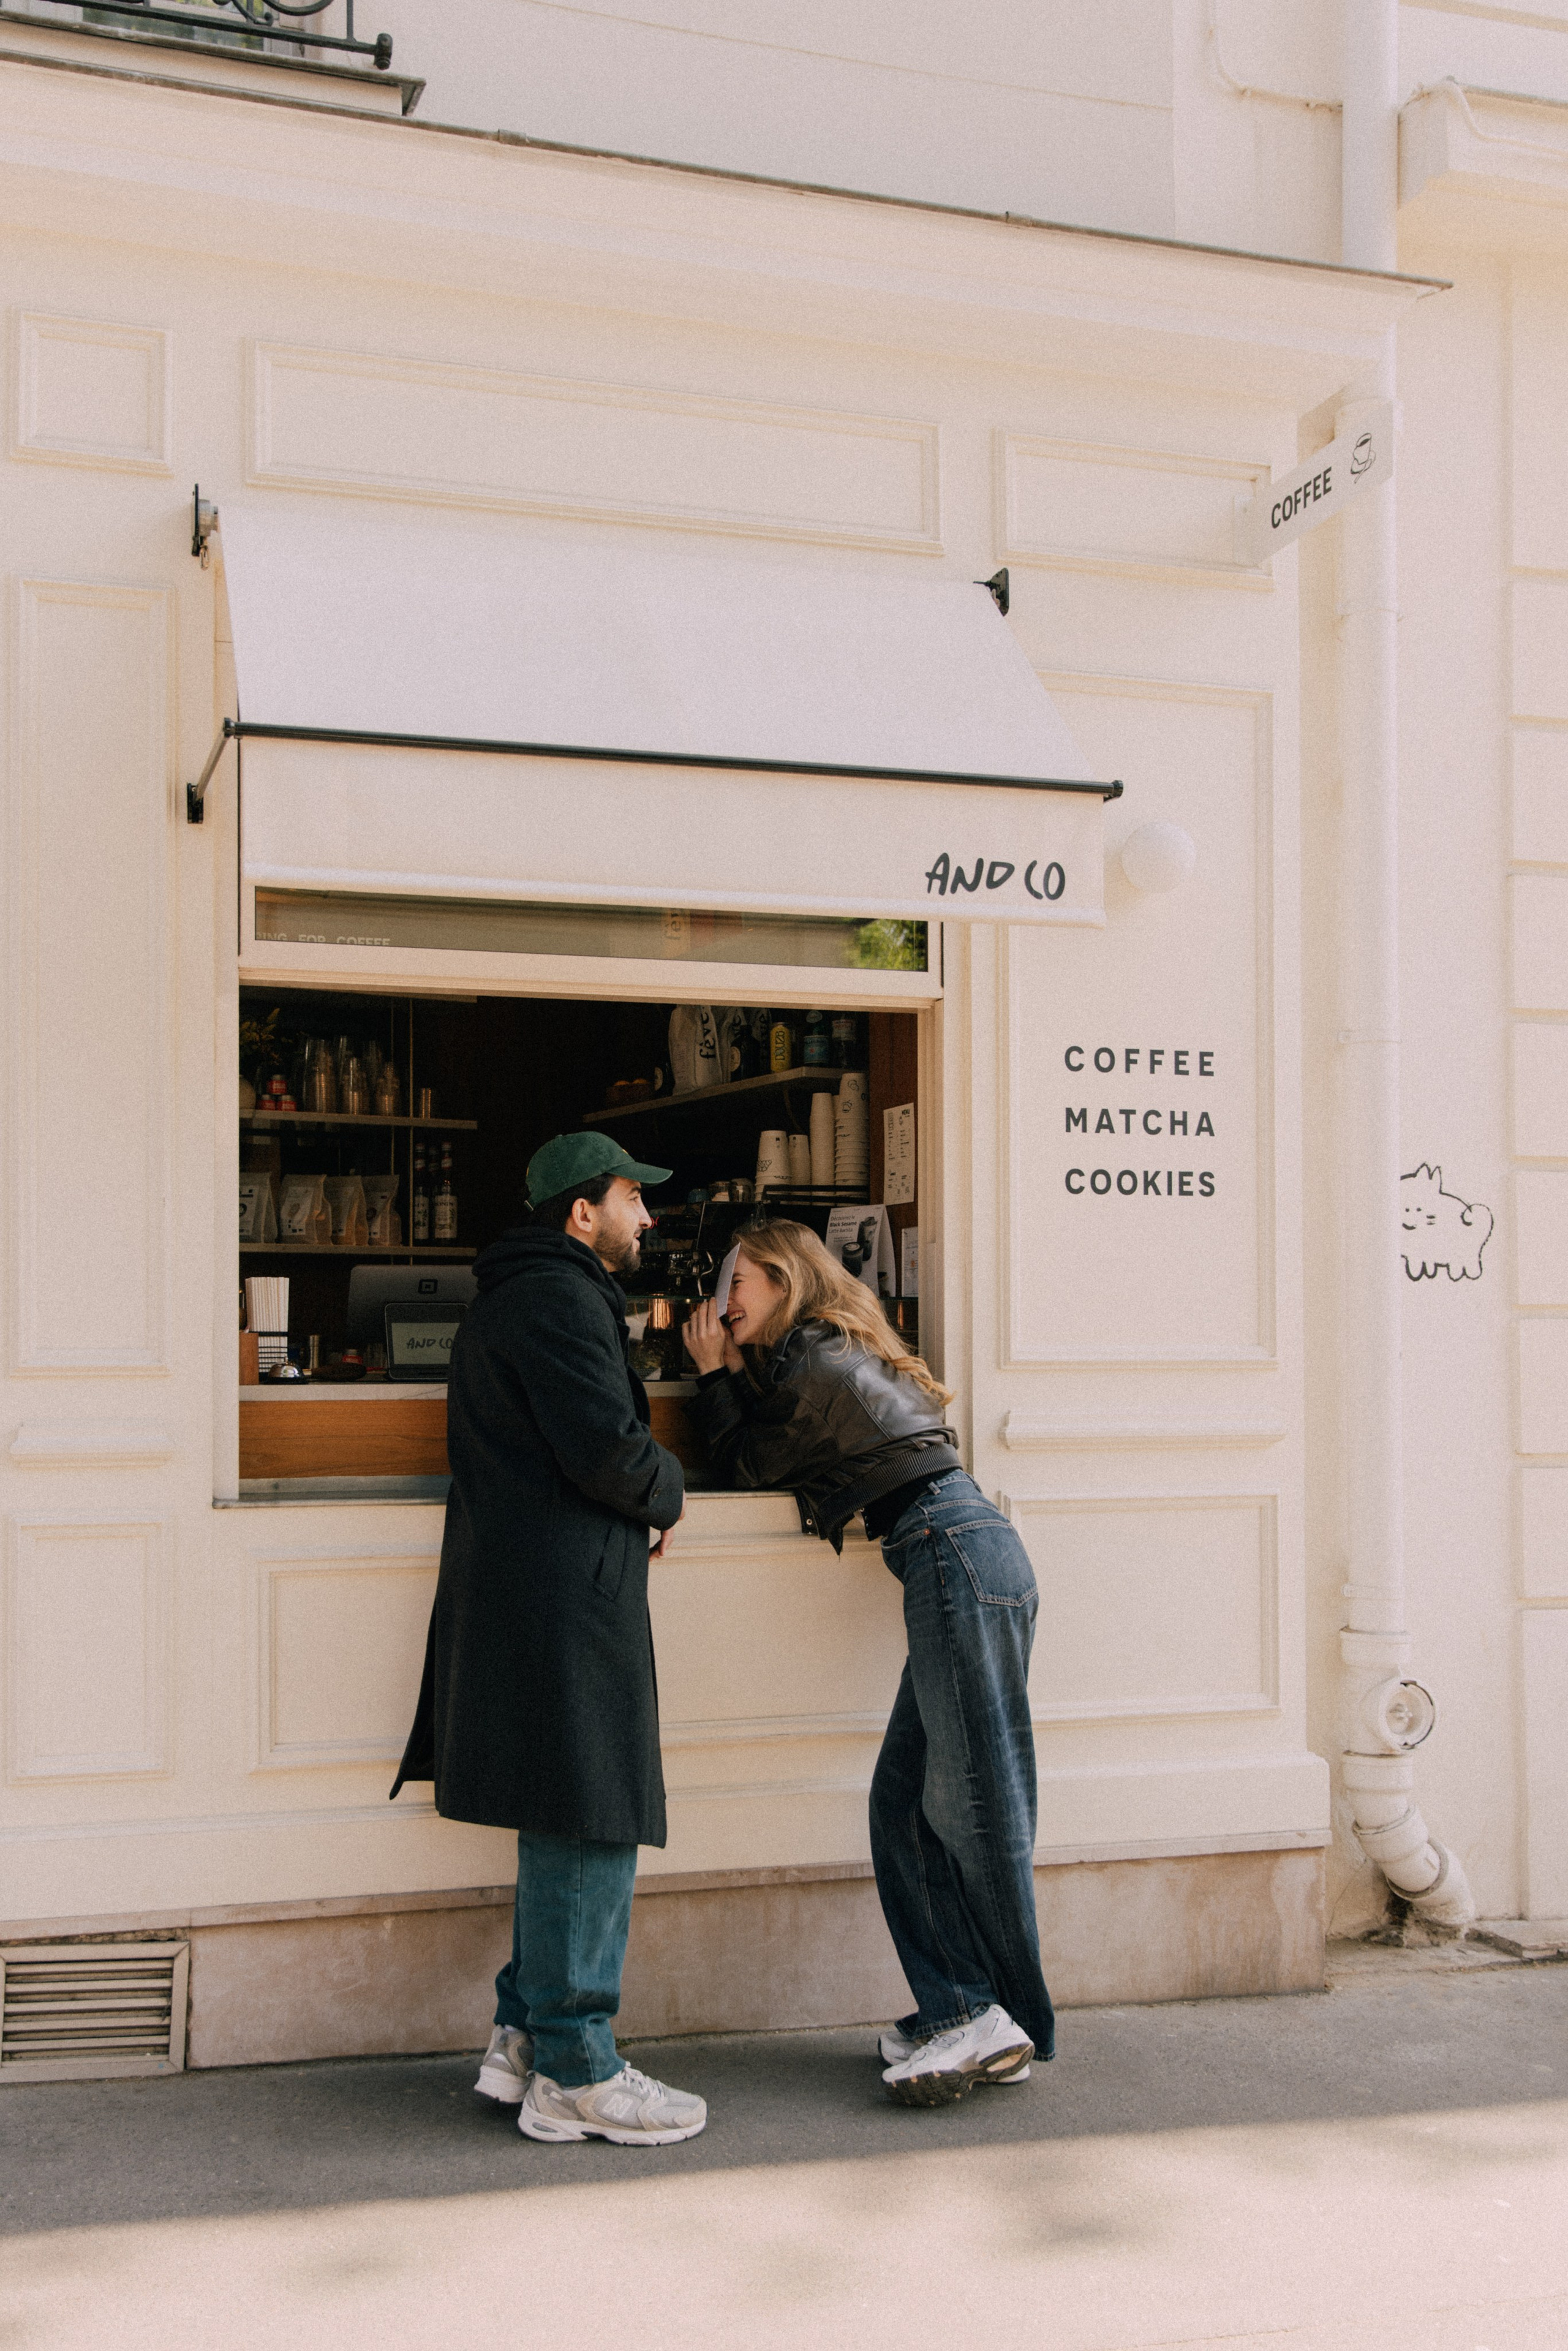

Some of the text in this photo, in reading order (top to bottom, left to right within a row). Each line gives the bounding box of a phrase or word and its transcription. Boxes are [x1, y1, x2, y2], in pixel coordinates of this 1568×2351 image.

[1270, 466, 1332, 529] COFFEE
[925, 852, 1065, 900] AND CO
[1065, 1046, 1214, 1076] COFFEE
[1065, 1107, 1215, 1136] MATCHA
[1065, 1168, 1215, 1197] COOKIES
[406, 1337, 453, 1349] AND CO
